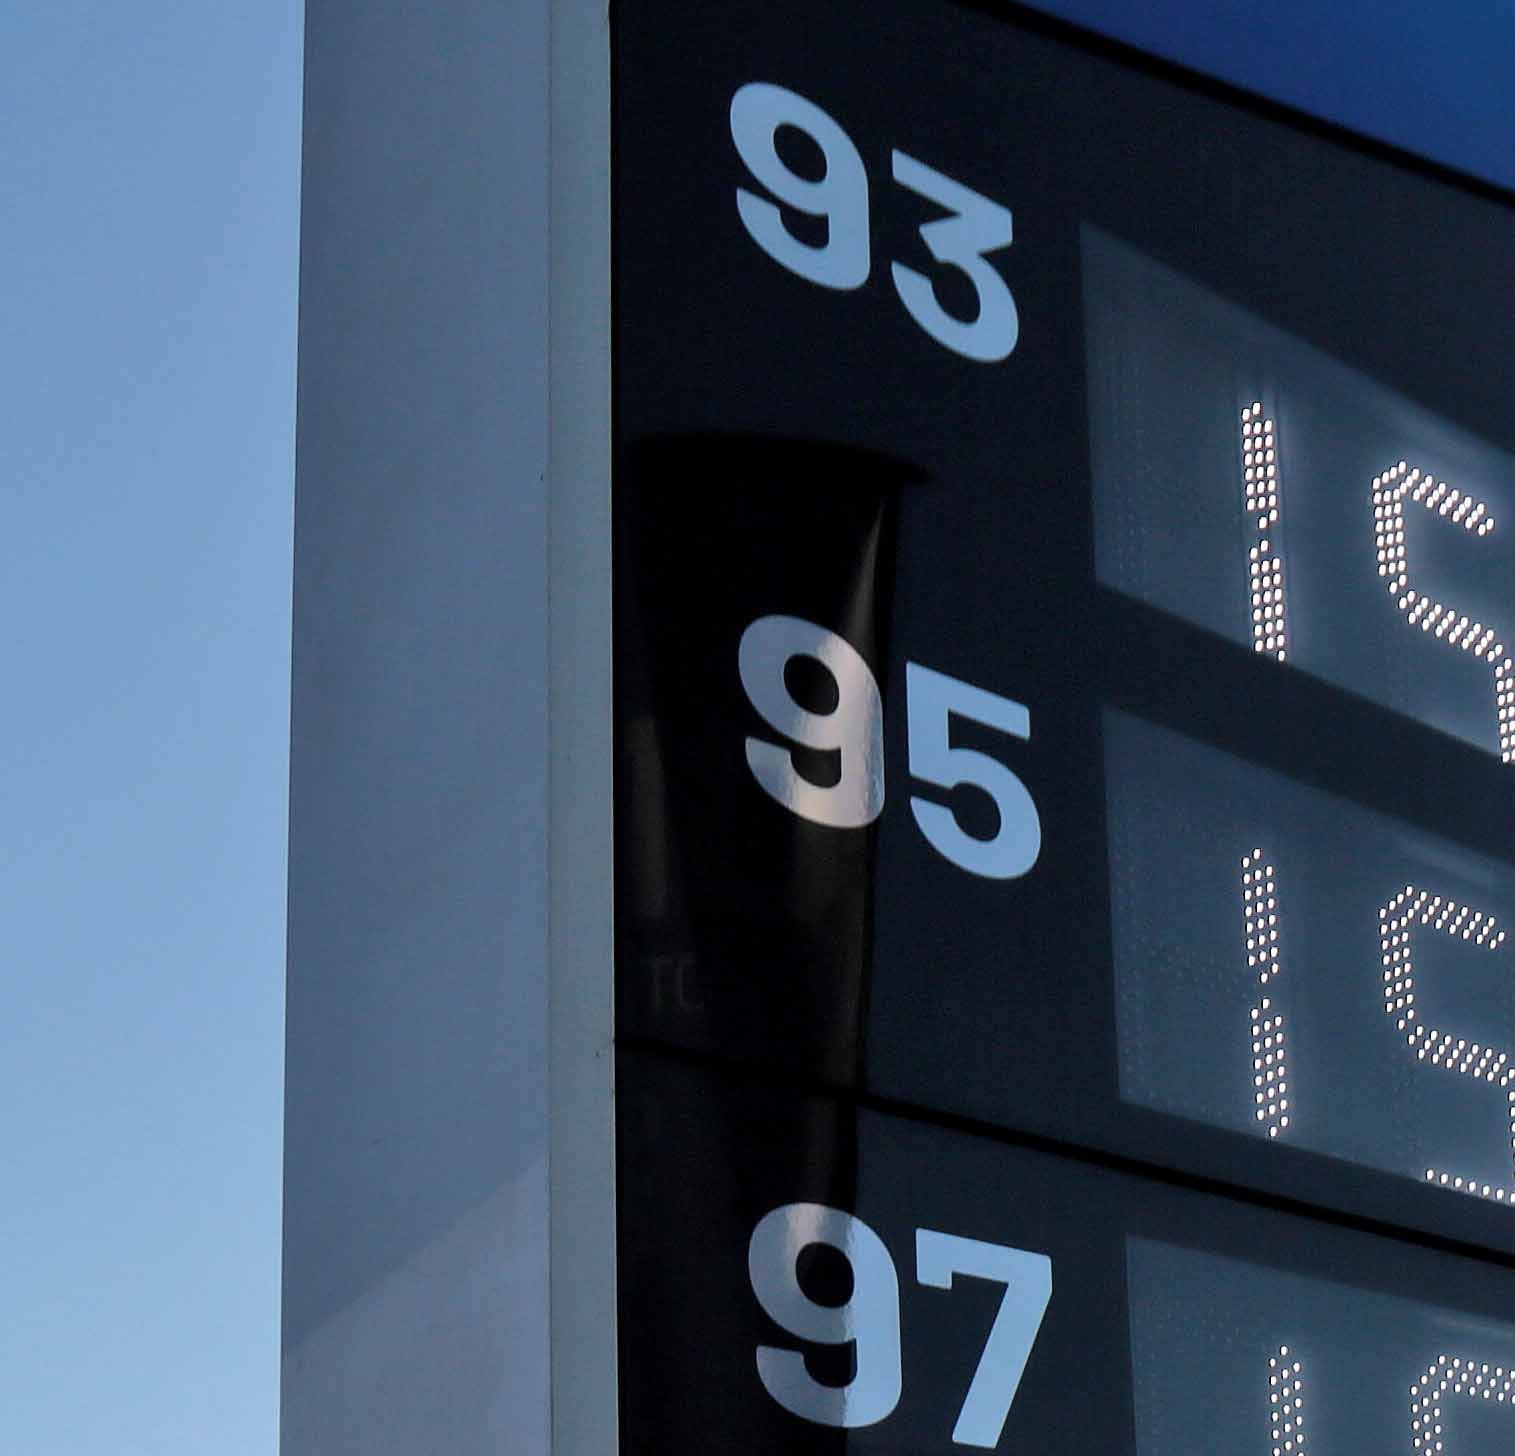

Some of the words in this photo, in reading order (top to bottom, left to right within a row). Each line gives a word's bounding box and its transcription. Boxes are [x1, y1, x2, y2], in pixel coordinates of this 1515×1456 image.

[728, 81, 1020, 364] 93
[737, 615, 1042, 880] 95
[748, 1202, 1054, 1450] 97
